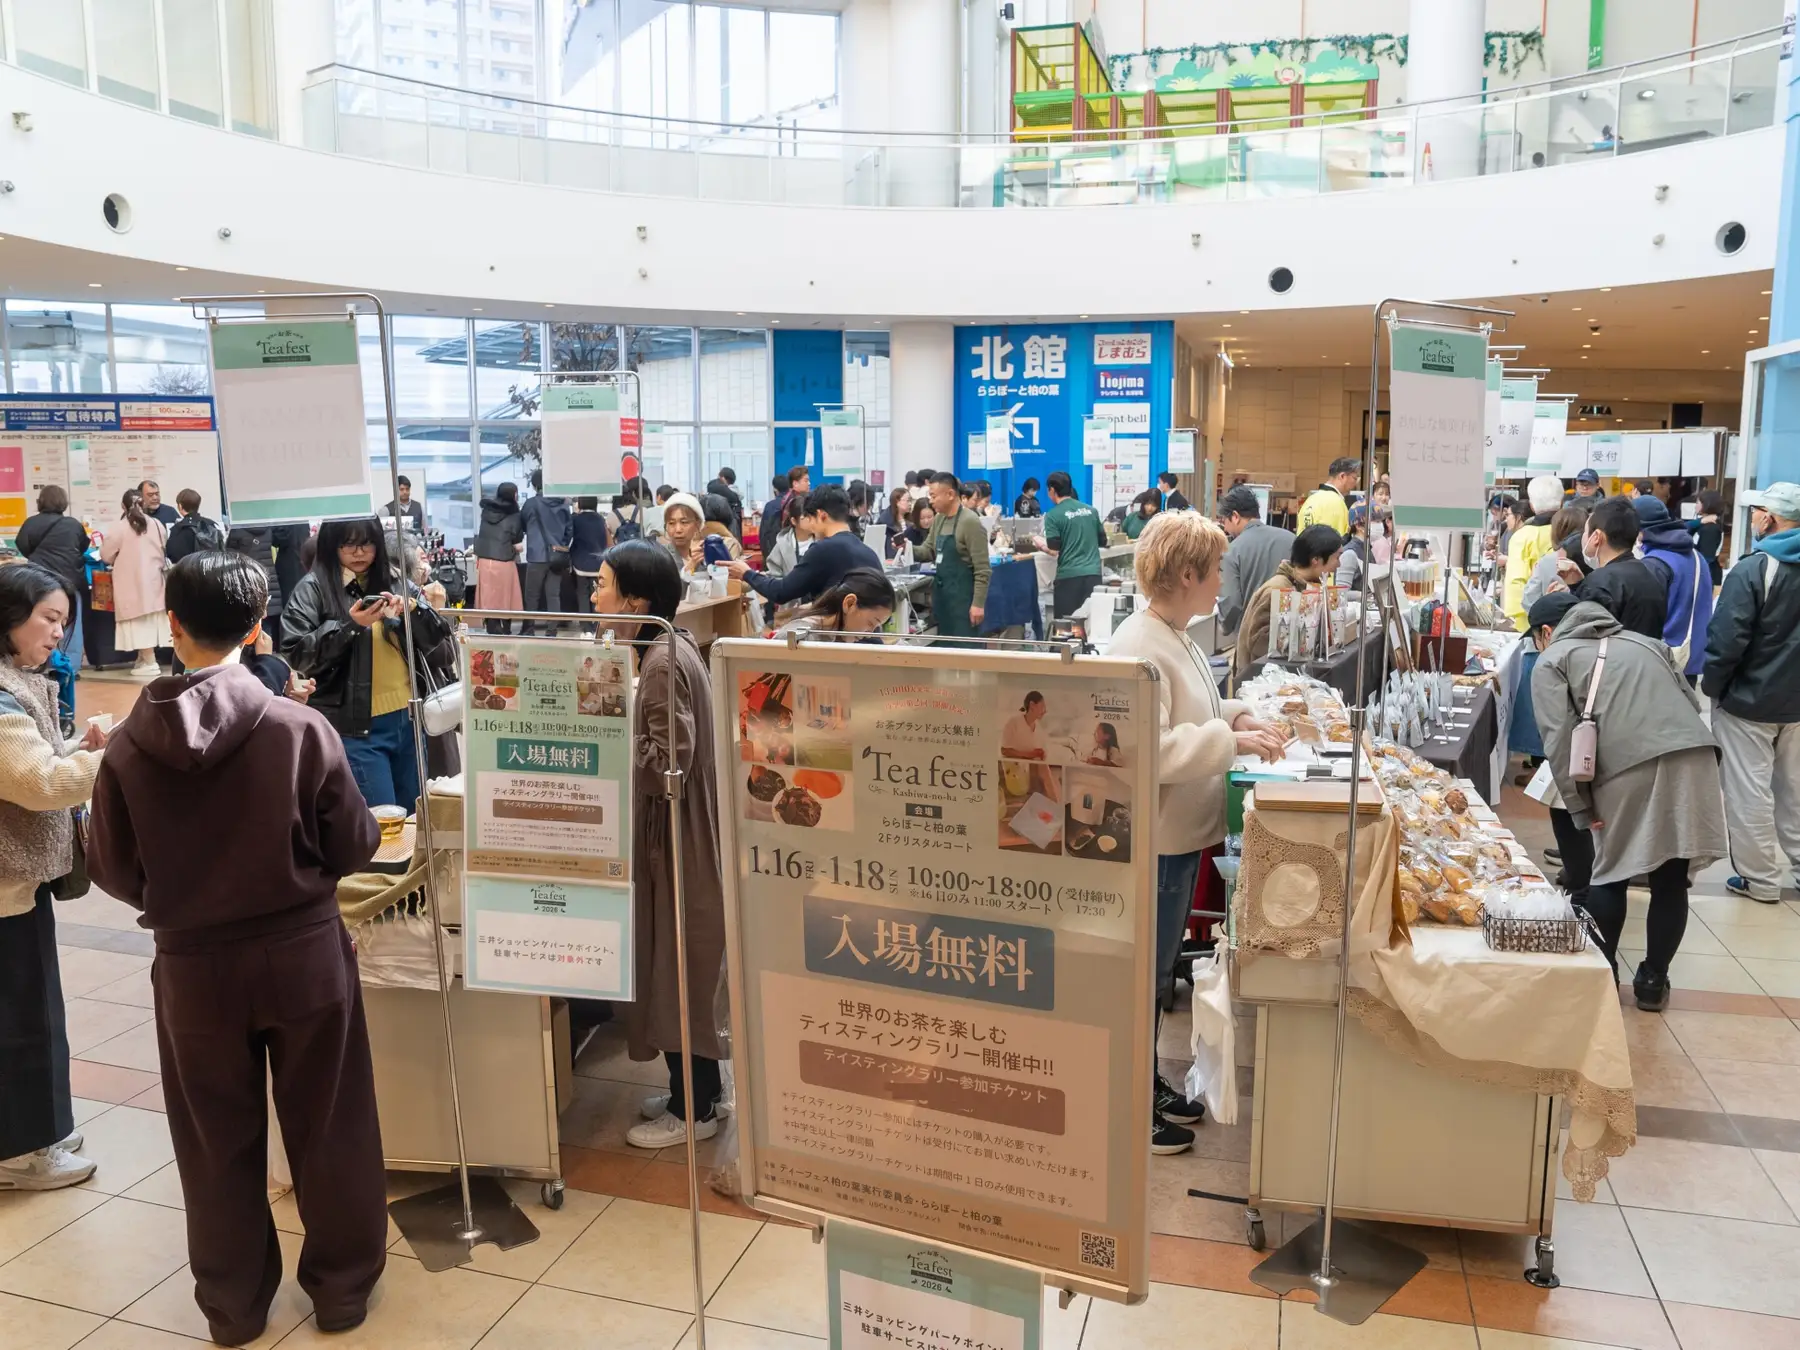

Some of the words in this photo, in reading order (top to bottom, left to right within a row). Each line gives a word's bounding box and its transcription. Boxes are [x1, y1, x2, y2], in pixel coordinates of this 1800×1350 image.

[971, 334, 1066, 380] 北館
[1098, 346, 1147, 359] しまむら
[977, 384, 1060, 396] ららぽーと柏の葉
[1591, 450, 1619, 463] 受付
[473, 719, 498, 731] 1.16
[509, 721, 533, 734] 1.18
[507, 743, 591, 769] 入場無料
[511, 778, 581, 791] 世界のお茶を楽しむ
[893, 787, 957, 802] Kashiwa-no-ha
[914, 805, 934, 817] 会場
[882, 817, 968, 836] ららぽーと柏の葉
[878, 832, 973, 853] 2Fクリスタルコート
[750, 845, 803, 880] 1.16
[804, 860, 814, 880] FRI
[830, 855, 885, 891] 1.18
[888, 869, 899, 894] SUN
[541, 905, 559, 913] 2026
[1075, 904, 1106, 917] 17:30
[493, 948, 603, 966] 駐車サービスは対象外です
[824, 914, 1034, 992] 入場無料
[837, 998, 1008, 1045] 世界のお茶を楽しむ
[921, 1279, 942, 1292] 2026
